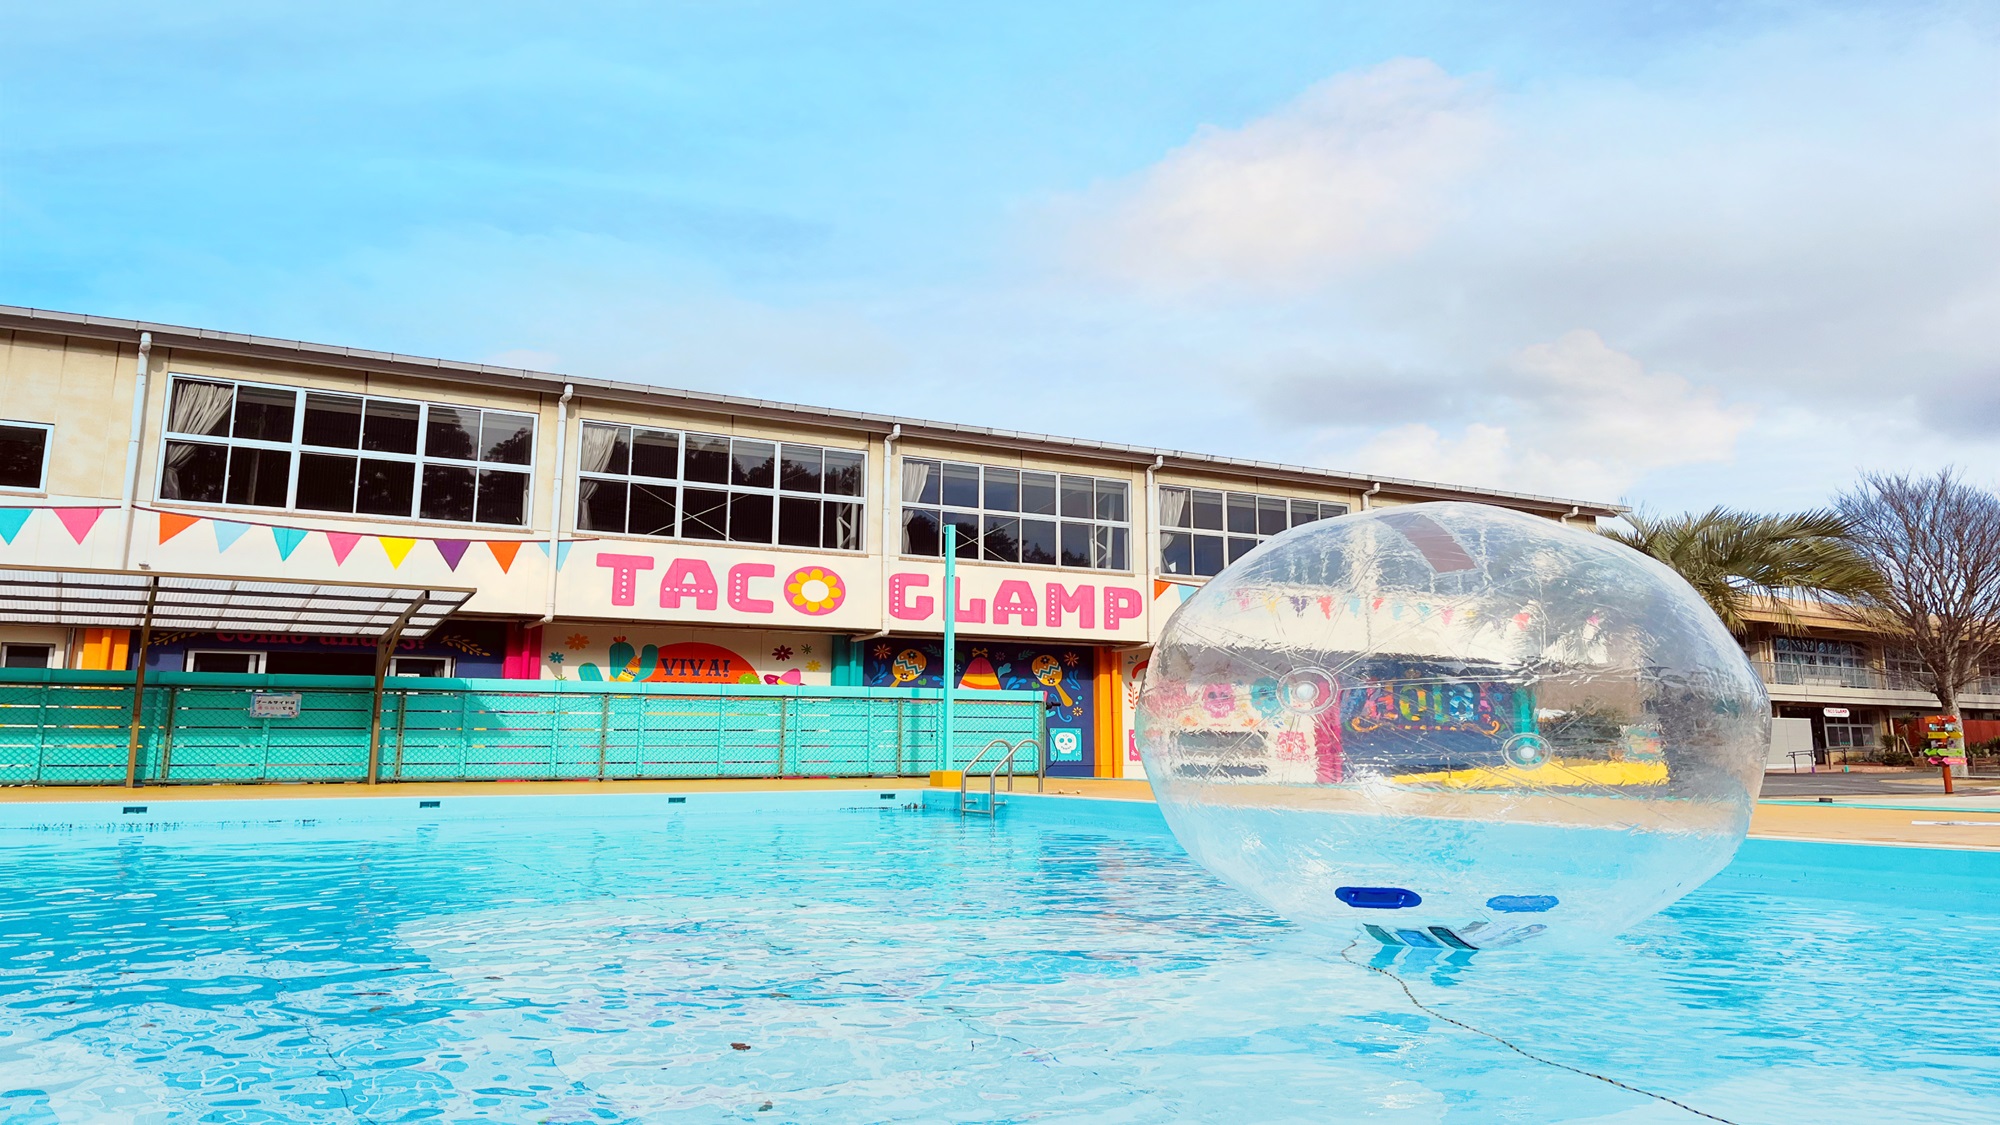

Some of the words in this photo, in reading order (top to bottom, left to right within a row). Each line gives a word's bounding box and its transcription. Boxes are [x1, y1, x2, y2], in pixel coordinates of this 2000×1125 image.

[595, 552, 847, 617] TACO
[888, 572, 1143, 631] GLAMP
[660, 657, 731, 678] VIVA!
